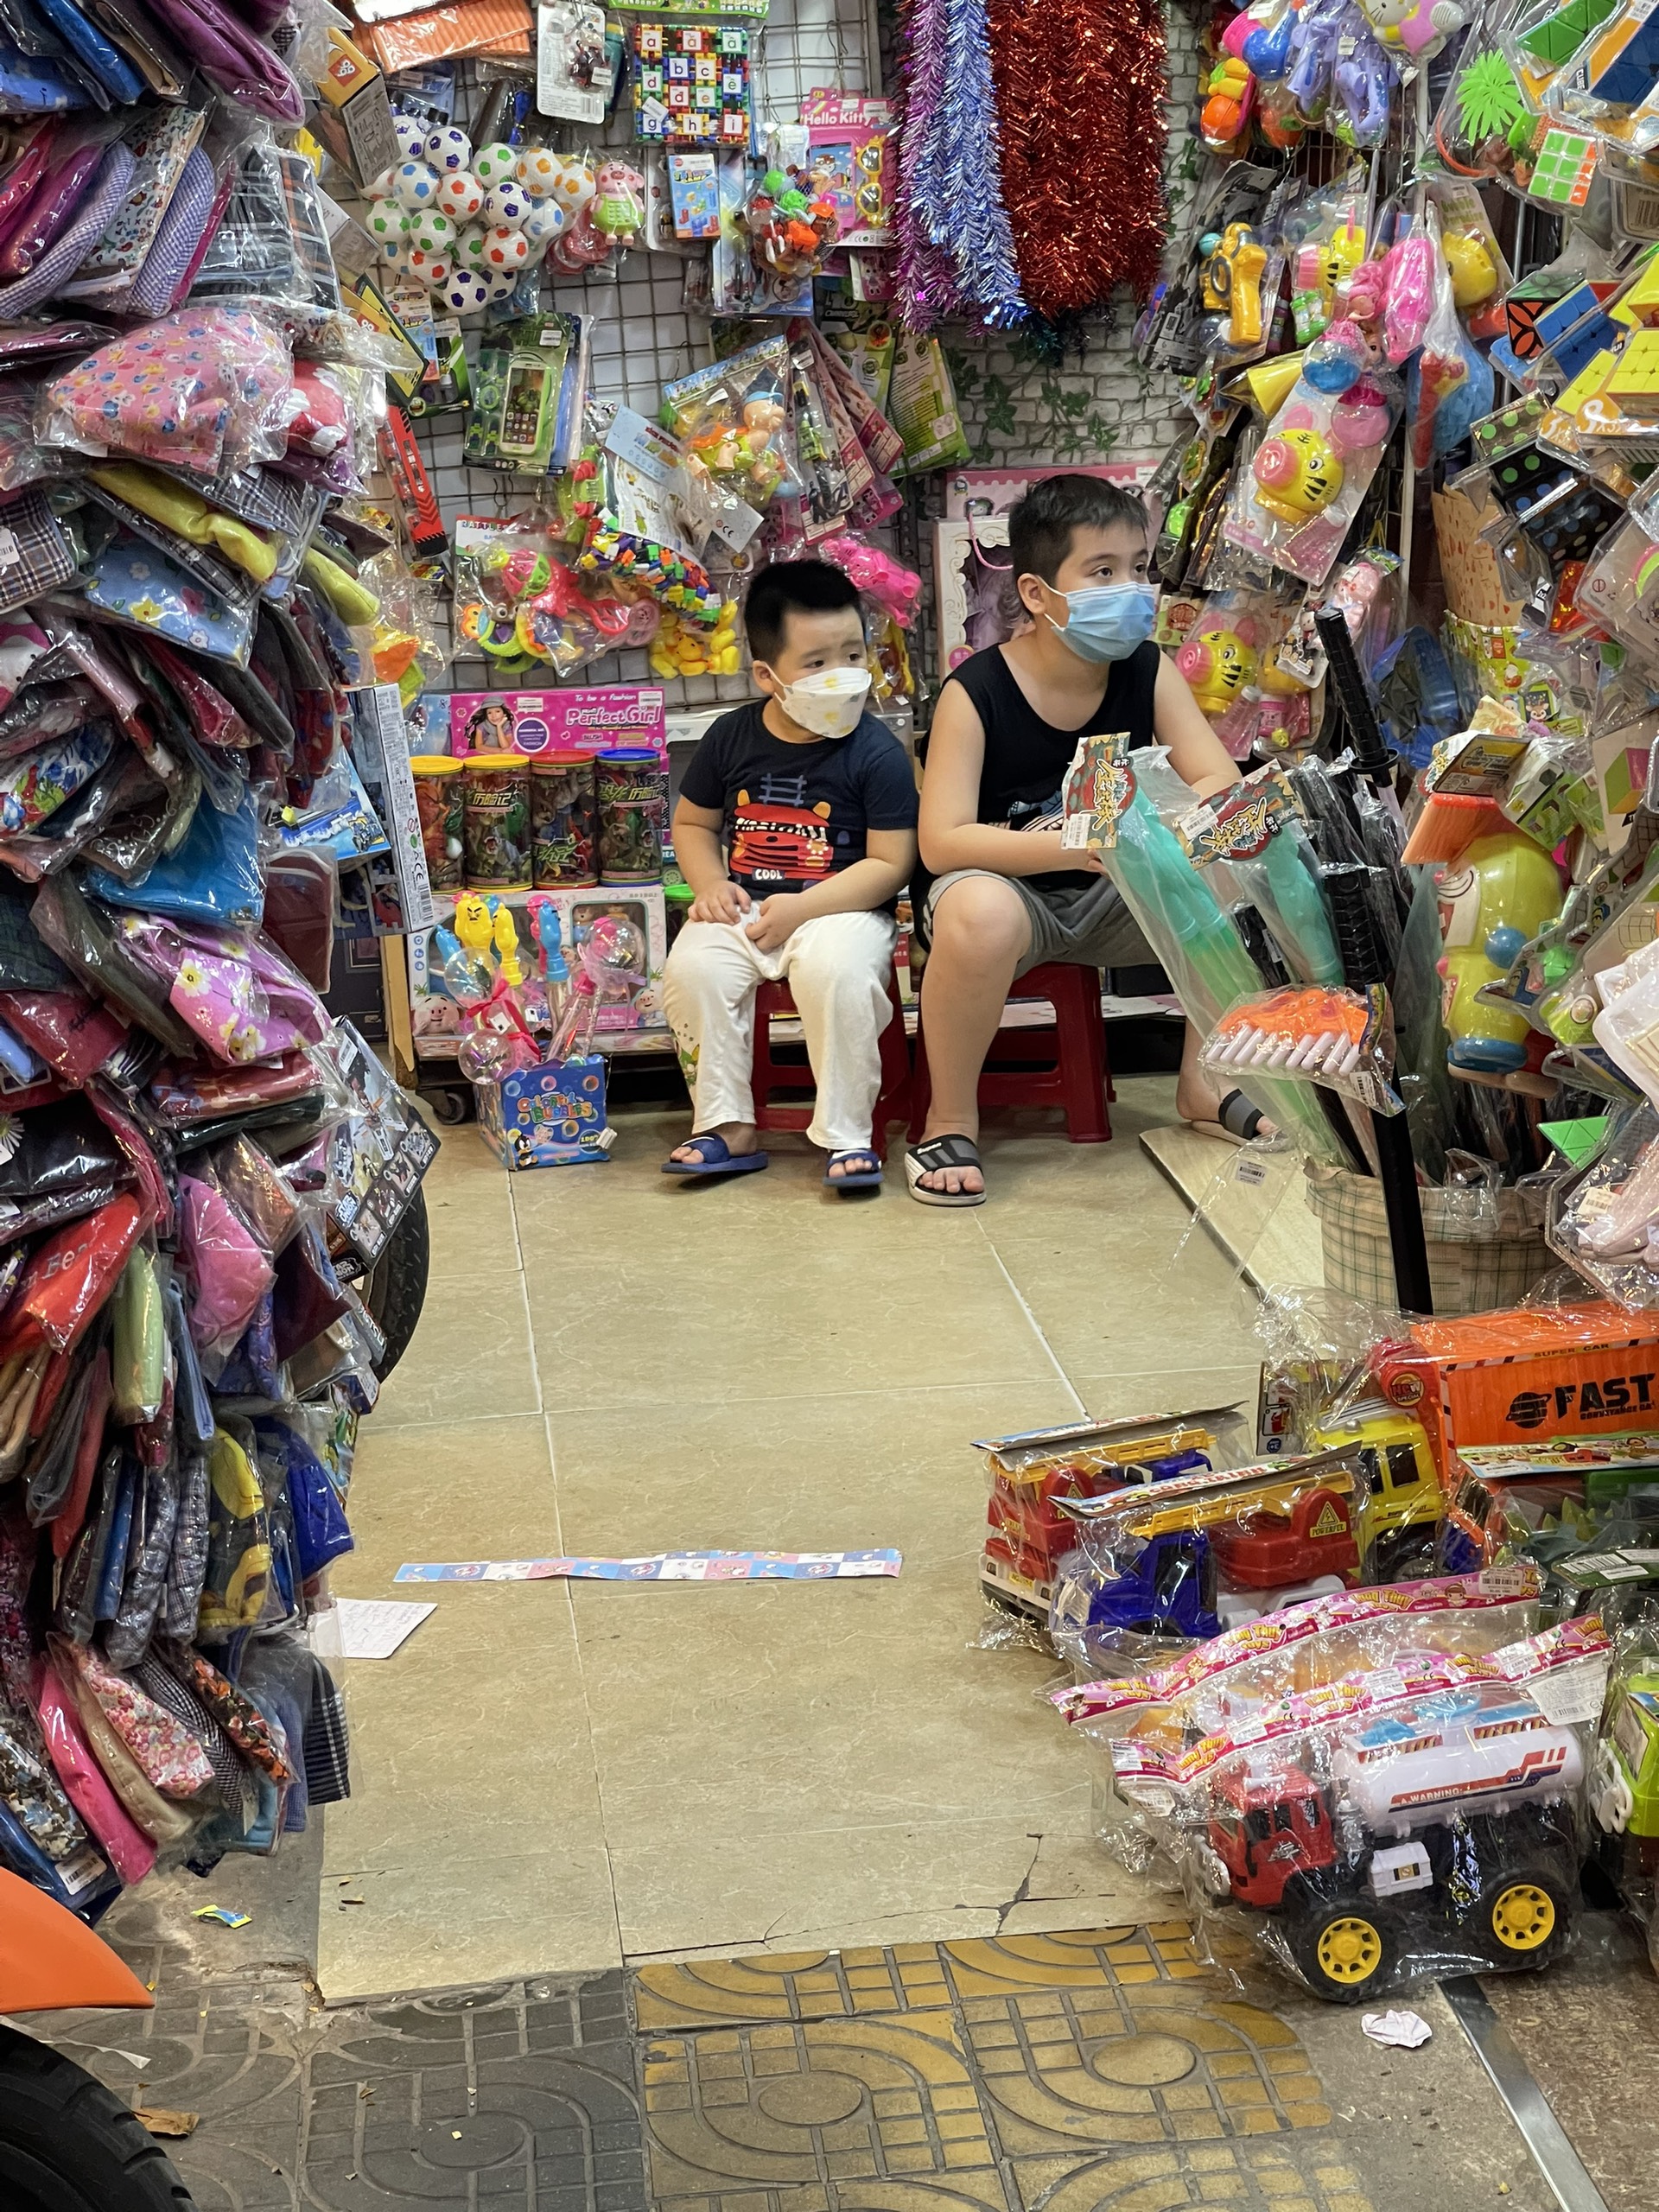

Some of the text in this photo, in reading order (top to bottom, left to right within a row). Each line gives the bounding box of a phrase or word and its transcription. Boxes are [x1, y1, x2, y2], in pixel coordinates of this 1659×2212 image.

[646, 37, 657, 48] a
[728, 36, 737, 48] â
[674, 62, 683, 75] b
[701, 67, 709, 77] c
[647, 76, 657, 89] d
[728, 78, 737, 91] ê
[701, 94, 709, 104] e
[648, 118, 657, 131] g
[689, 118, 696, 131] h
[804, 111, 872, 127] Hello Kitty
[566, 704, 662, 726] Perfect Girl
[755, 868, 783, 880] COOL
[1535, 1348, 1575, 1357] SUPER
[1555, 1373, 1656, 1419] FAST
[1312, 1523, 1345, 1537] POWERFUL
